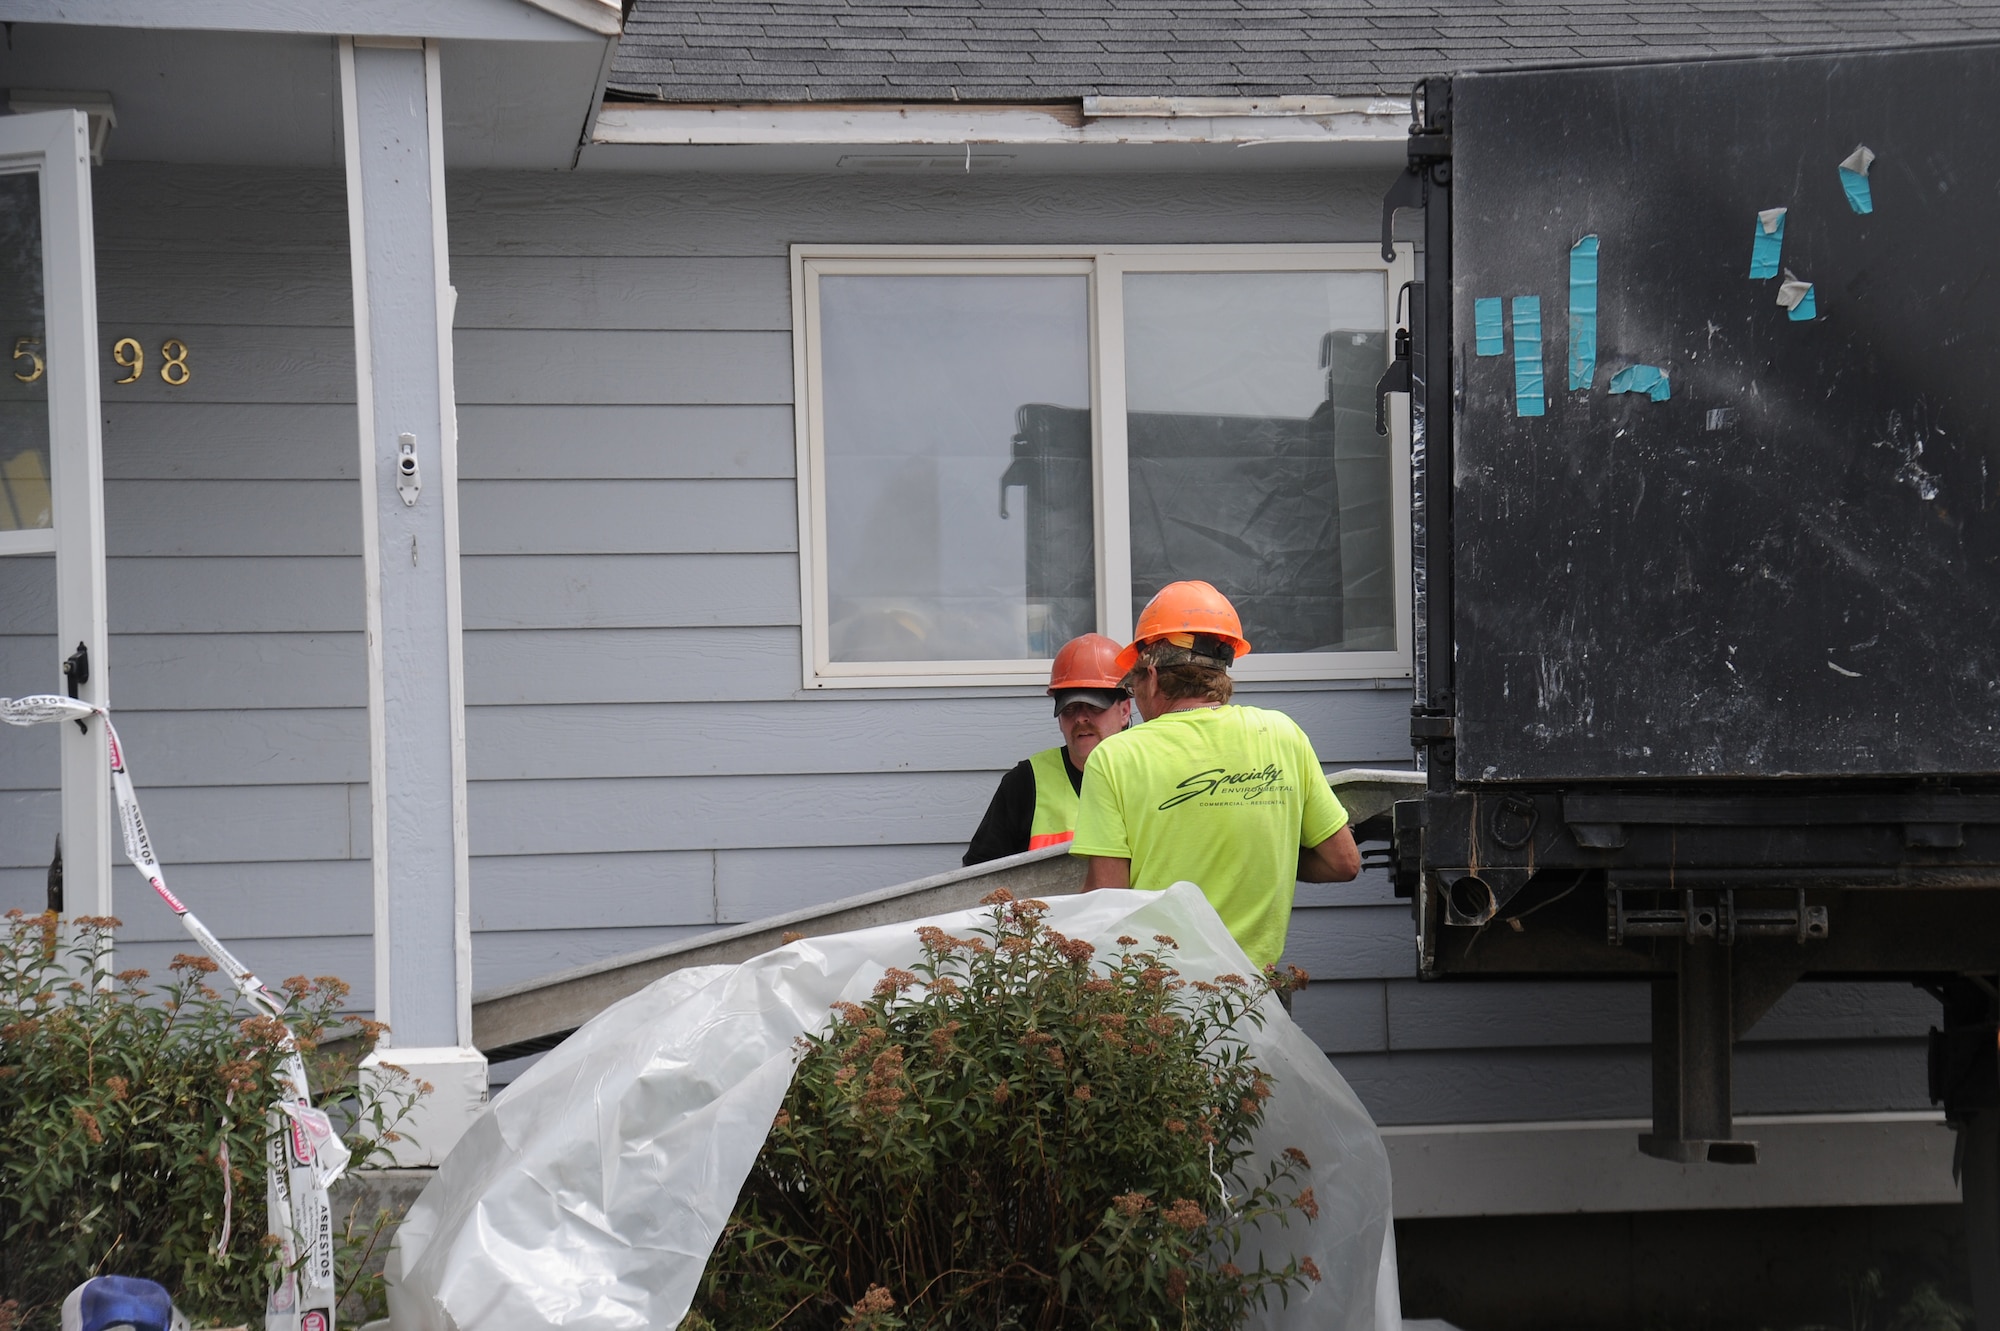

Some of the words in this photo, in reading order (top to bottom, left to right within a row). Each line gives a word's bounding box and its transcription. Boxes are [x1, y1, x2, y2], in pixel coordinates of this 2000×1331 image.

[1158, 763, 1283, 811] Specialty
[132, 804, 154, 866] ASBESTOS
[274, 1136, 289, 1201] ASBESTO
[319, 1205, 330, 1277] ASBESTOS
